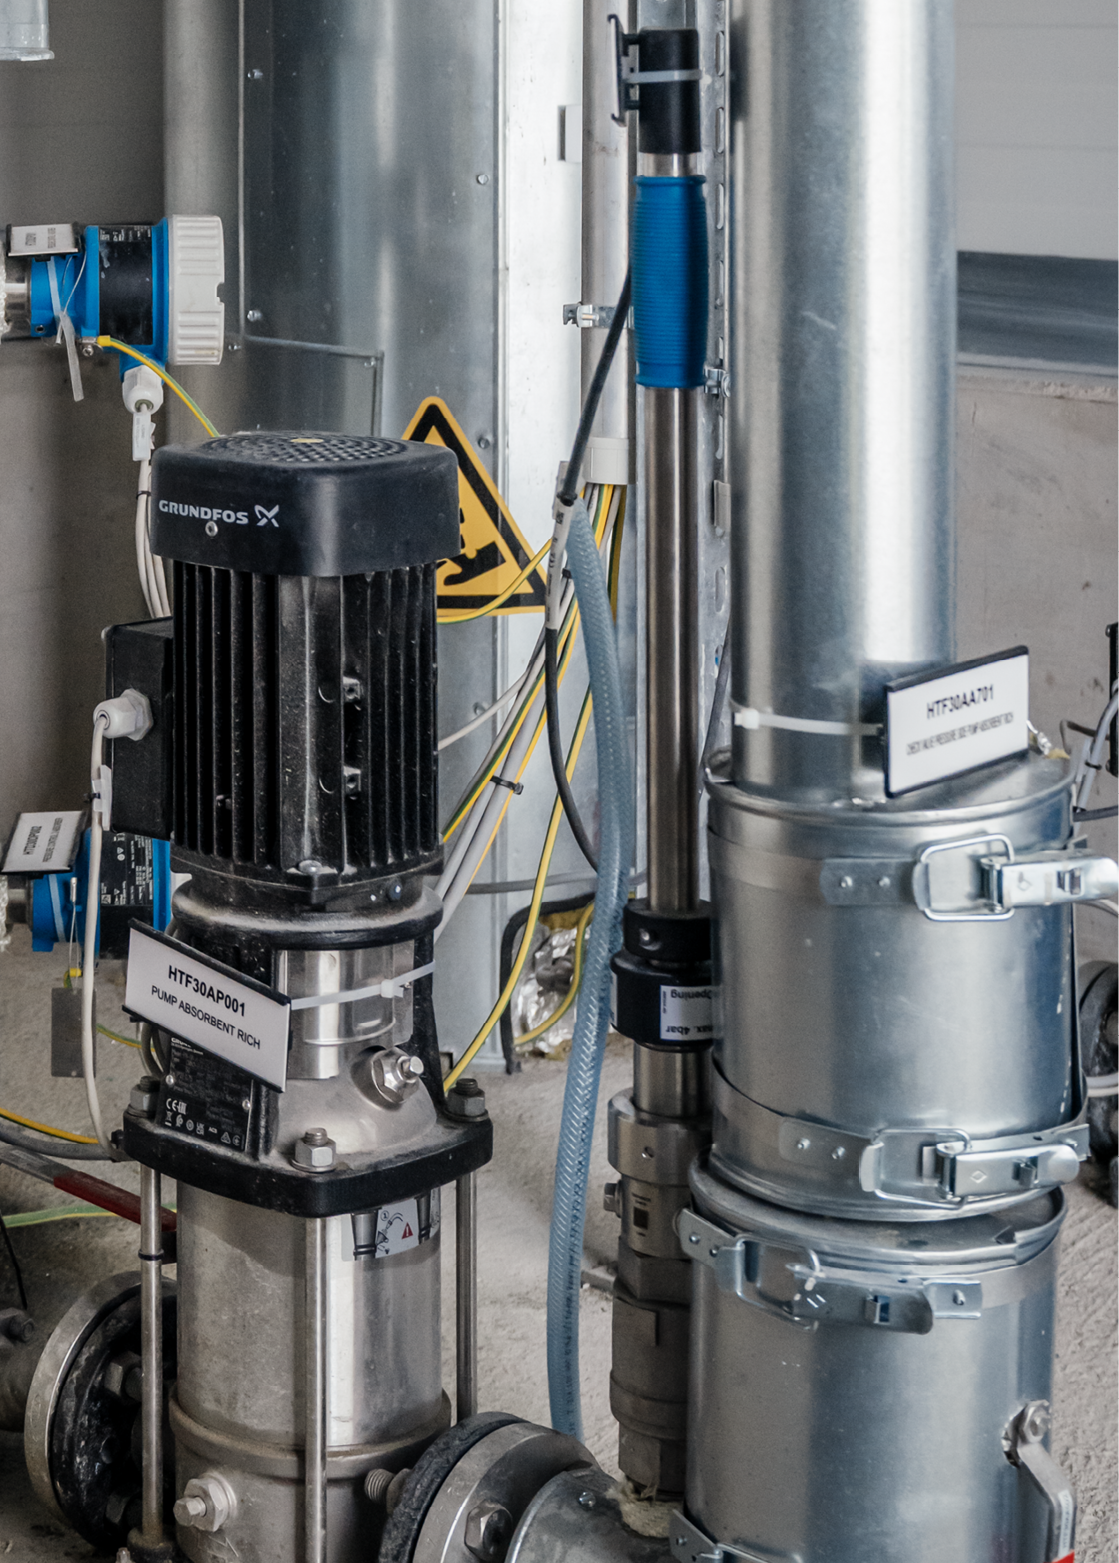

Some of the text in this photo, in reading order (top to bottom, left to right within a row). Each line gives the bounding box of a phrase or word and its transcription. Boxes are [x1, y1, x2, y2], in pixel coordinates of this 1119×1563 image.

[158, 499, 249, 525] GRUNDFOS
[168, 964, 245, 1017] HTF30AP001
[151, 985, 261, 1050] PUMP ABSORBENT RICH
